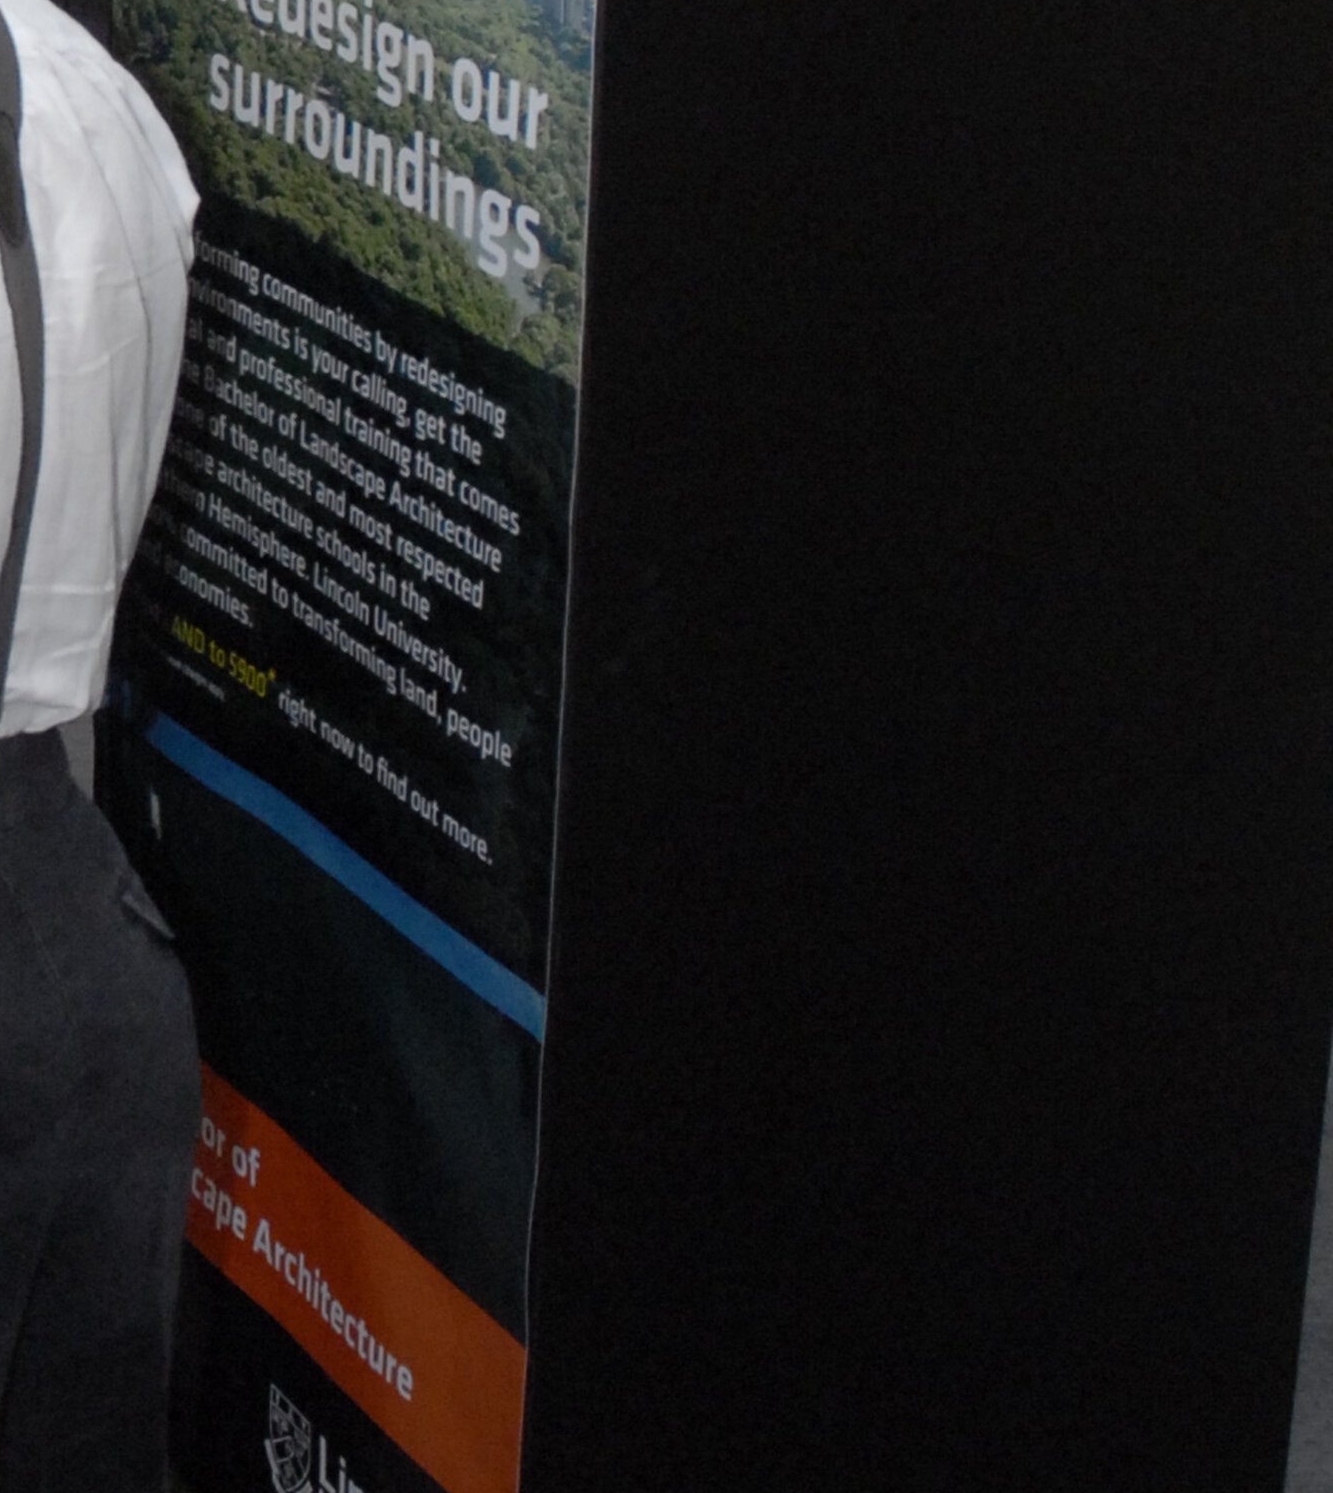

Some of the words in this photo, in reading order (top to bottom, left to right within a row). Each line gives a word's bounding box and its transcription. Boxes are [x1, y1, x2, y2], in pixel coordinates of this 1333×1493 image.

[209, 52, 541, 280] surroundings
[451, 55, 549, 151] our
[207, 328, 238, 363] and
[239, 348, 341, 427] professional
[345, 406, 412, 479] training
[414, 450, 456, 498] that
[459, 479, 521, 537] comes
[262, 272, 372, 354] communities
[375, 329, 398, 374] by
[399, 351, 507, 440] redesigning
[294, 326, 309, 361] is
[311, 344, 350, 384] your
[351, 368, 411, 429] calling,
[415, 407, 447, 446] get
[450, 422, 483, 466] the
[203, 364, 275, 428] Bachelor
[278, 411, 298, 441] of
[300, 419, 387, 501] Landscape
[389, 479, 503, 573] Architecture
[208, 413, 228, 441] of
[229, 423, 259, 461] the
[261, 444, 313, 496] oldest
[315, 479, 347, 519] and
[349, 502, 394, 551] most
[395, 535, 484, 611] respected
[216, 460, 314, 540] architecture
[315, 524, 376, 585] schools
[379, 563, 397, 599] in
[399, 579, 431, 622] the
[181, 522, 268, 596] committed
[270, 577, 289, 610] to
[291, 591, 398, 696] transforming
[399, 666, 442, 726] land,
[446, 708, 513, 768] people
[208, 492, 310, 581] Hemisphere.
[313, 560, 370, 626] Lincoln
[373, 604, 467, 695] University.
[207, 639, 226, 669] to
[278, 688, 318, 734] right
[320, 720, 356, 761] now
[357, 742, 375, 776] to
[376, 755, 408, 803] find
[410, 790, 440, 828] out
[442, 812, 493, 867] more.
[232, 1144, 261, 1188] of
[251, 1217, 415, 1402] Architecture
